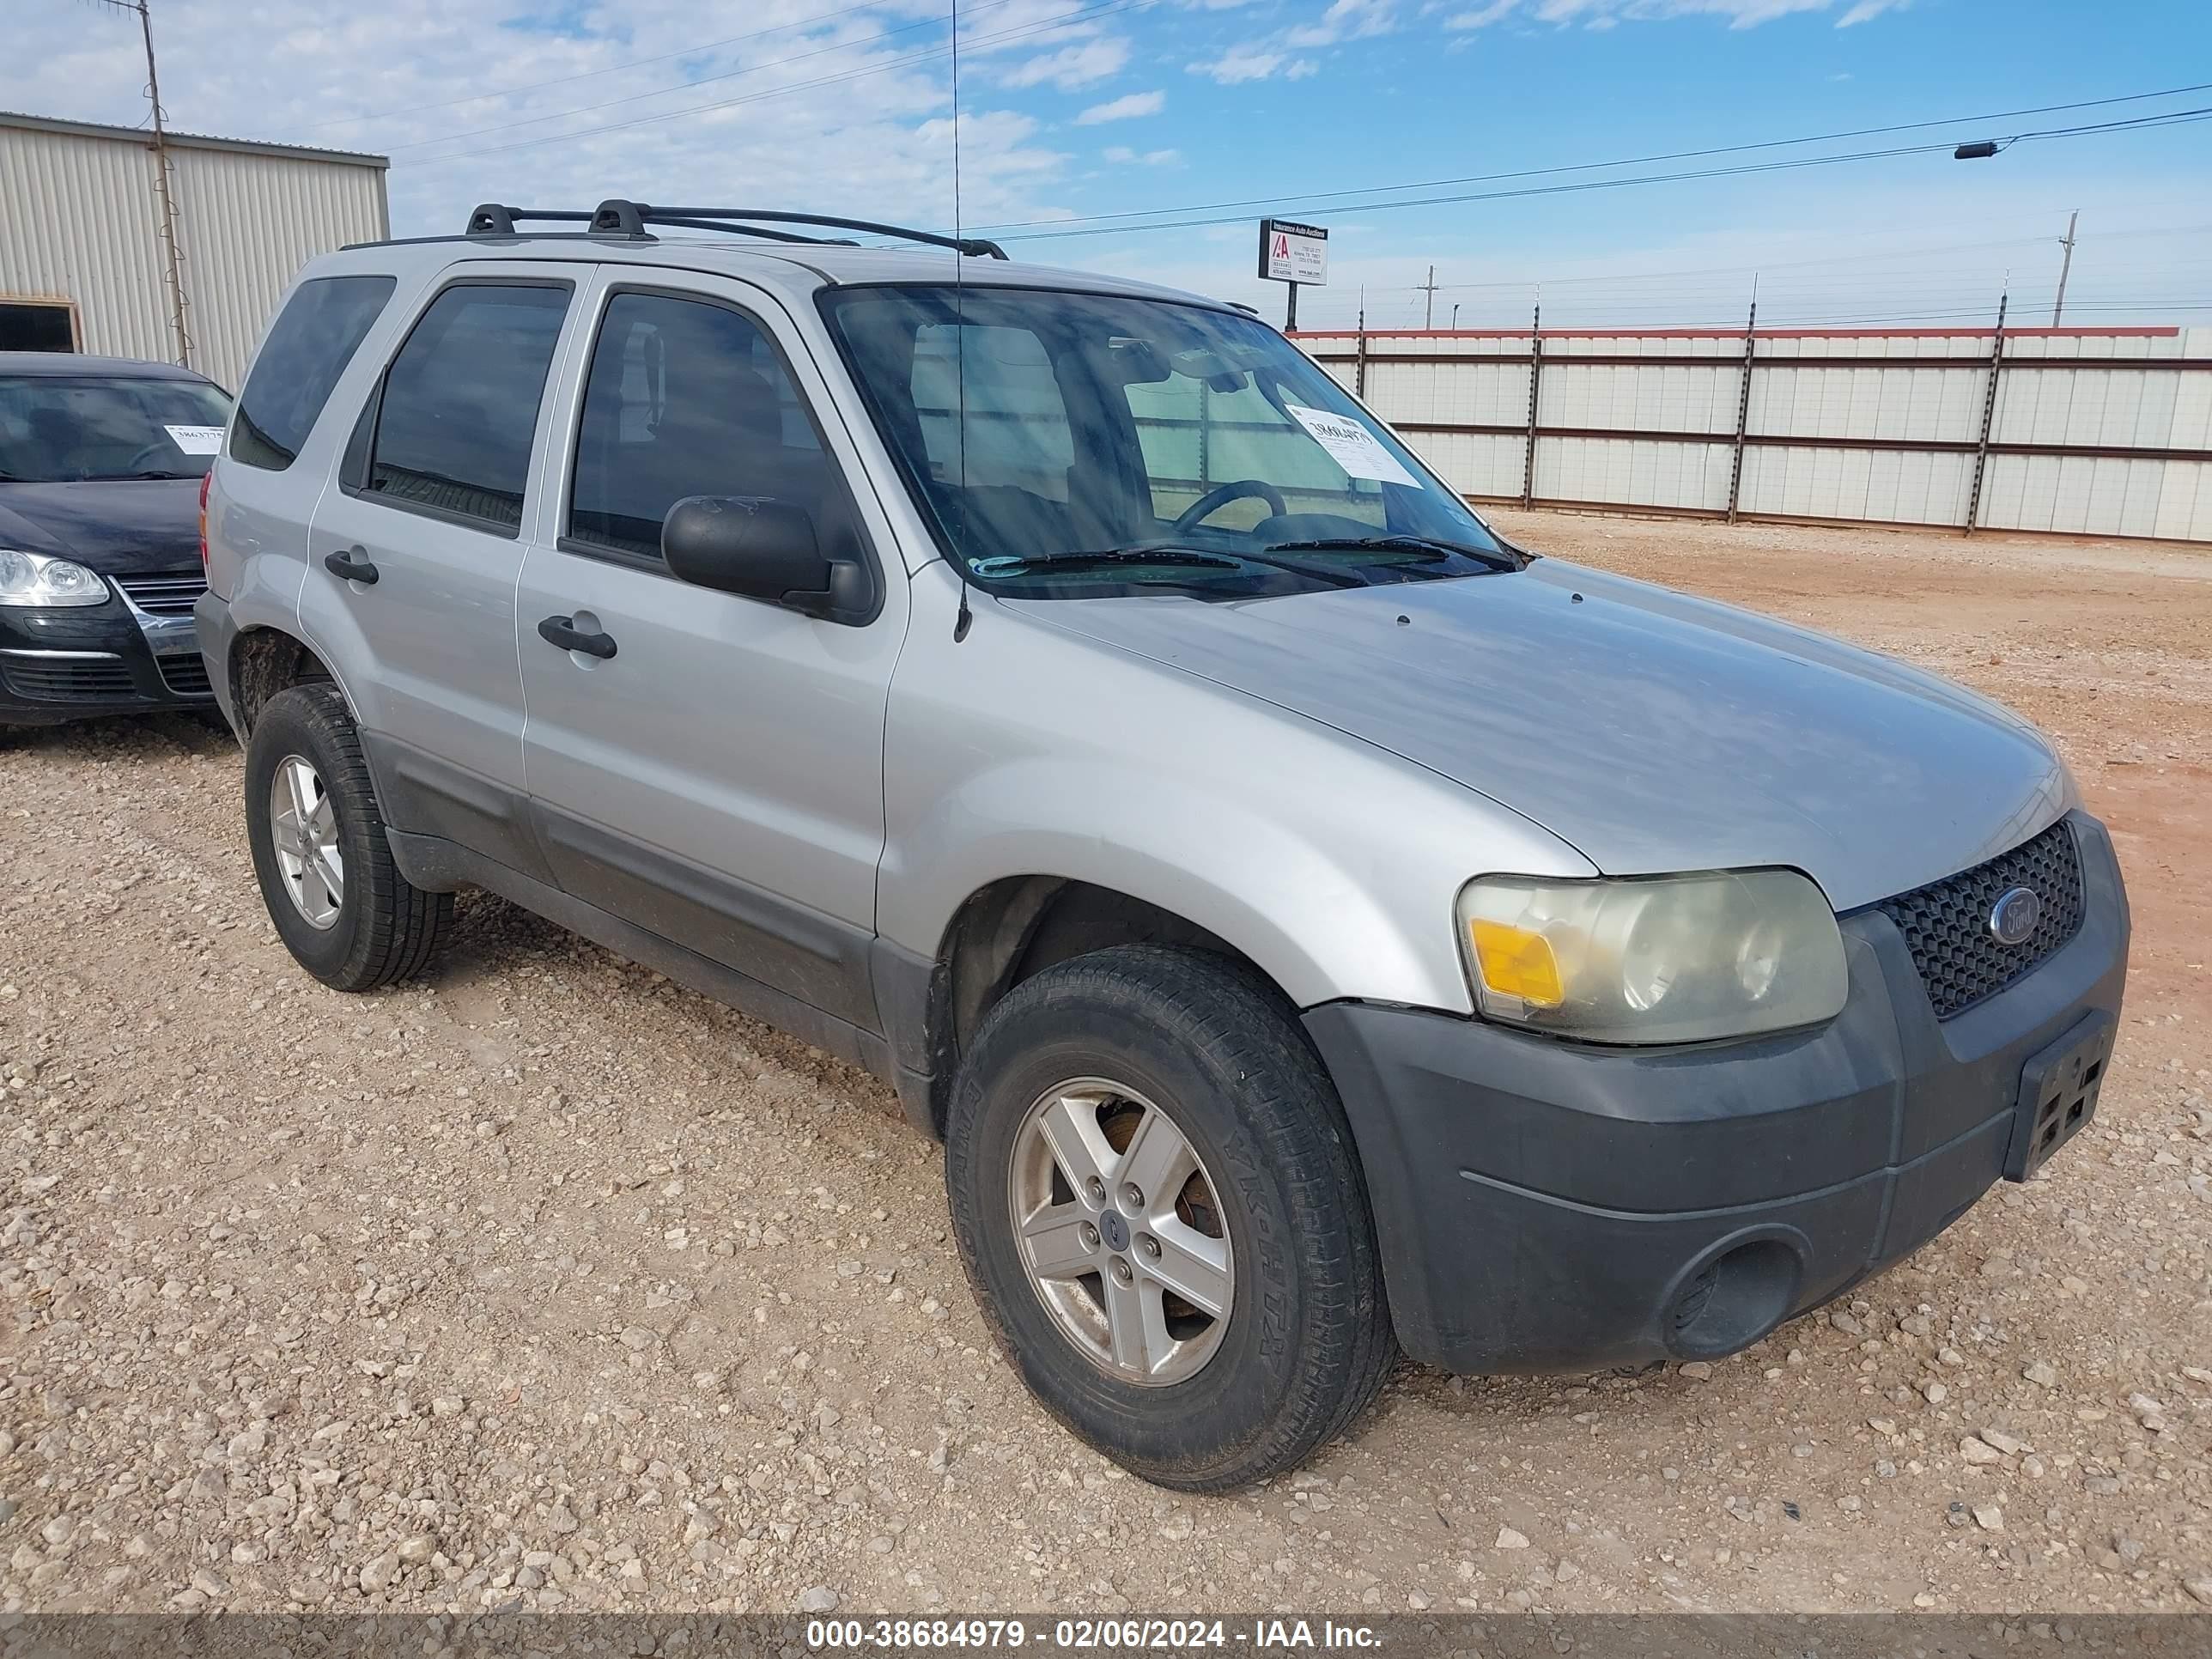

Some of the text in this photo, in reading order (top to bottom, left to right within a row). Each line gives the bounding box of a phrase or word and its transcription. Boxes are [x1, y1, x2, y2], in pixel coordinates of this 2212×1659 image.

[1273, 222, 1325, 238] Insurance Auto Auctions
